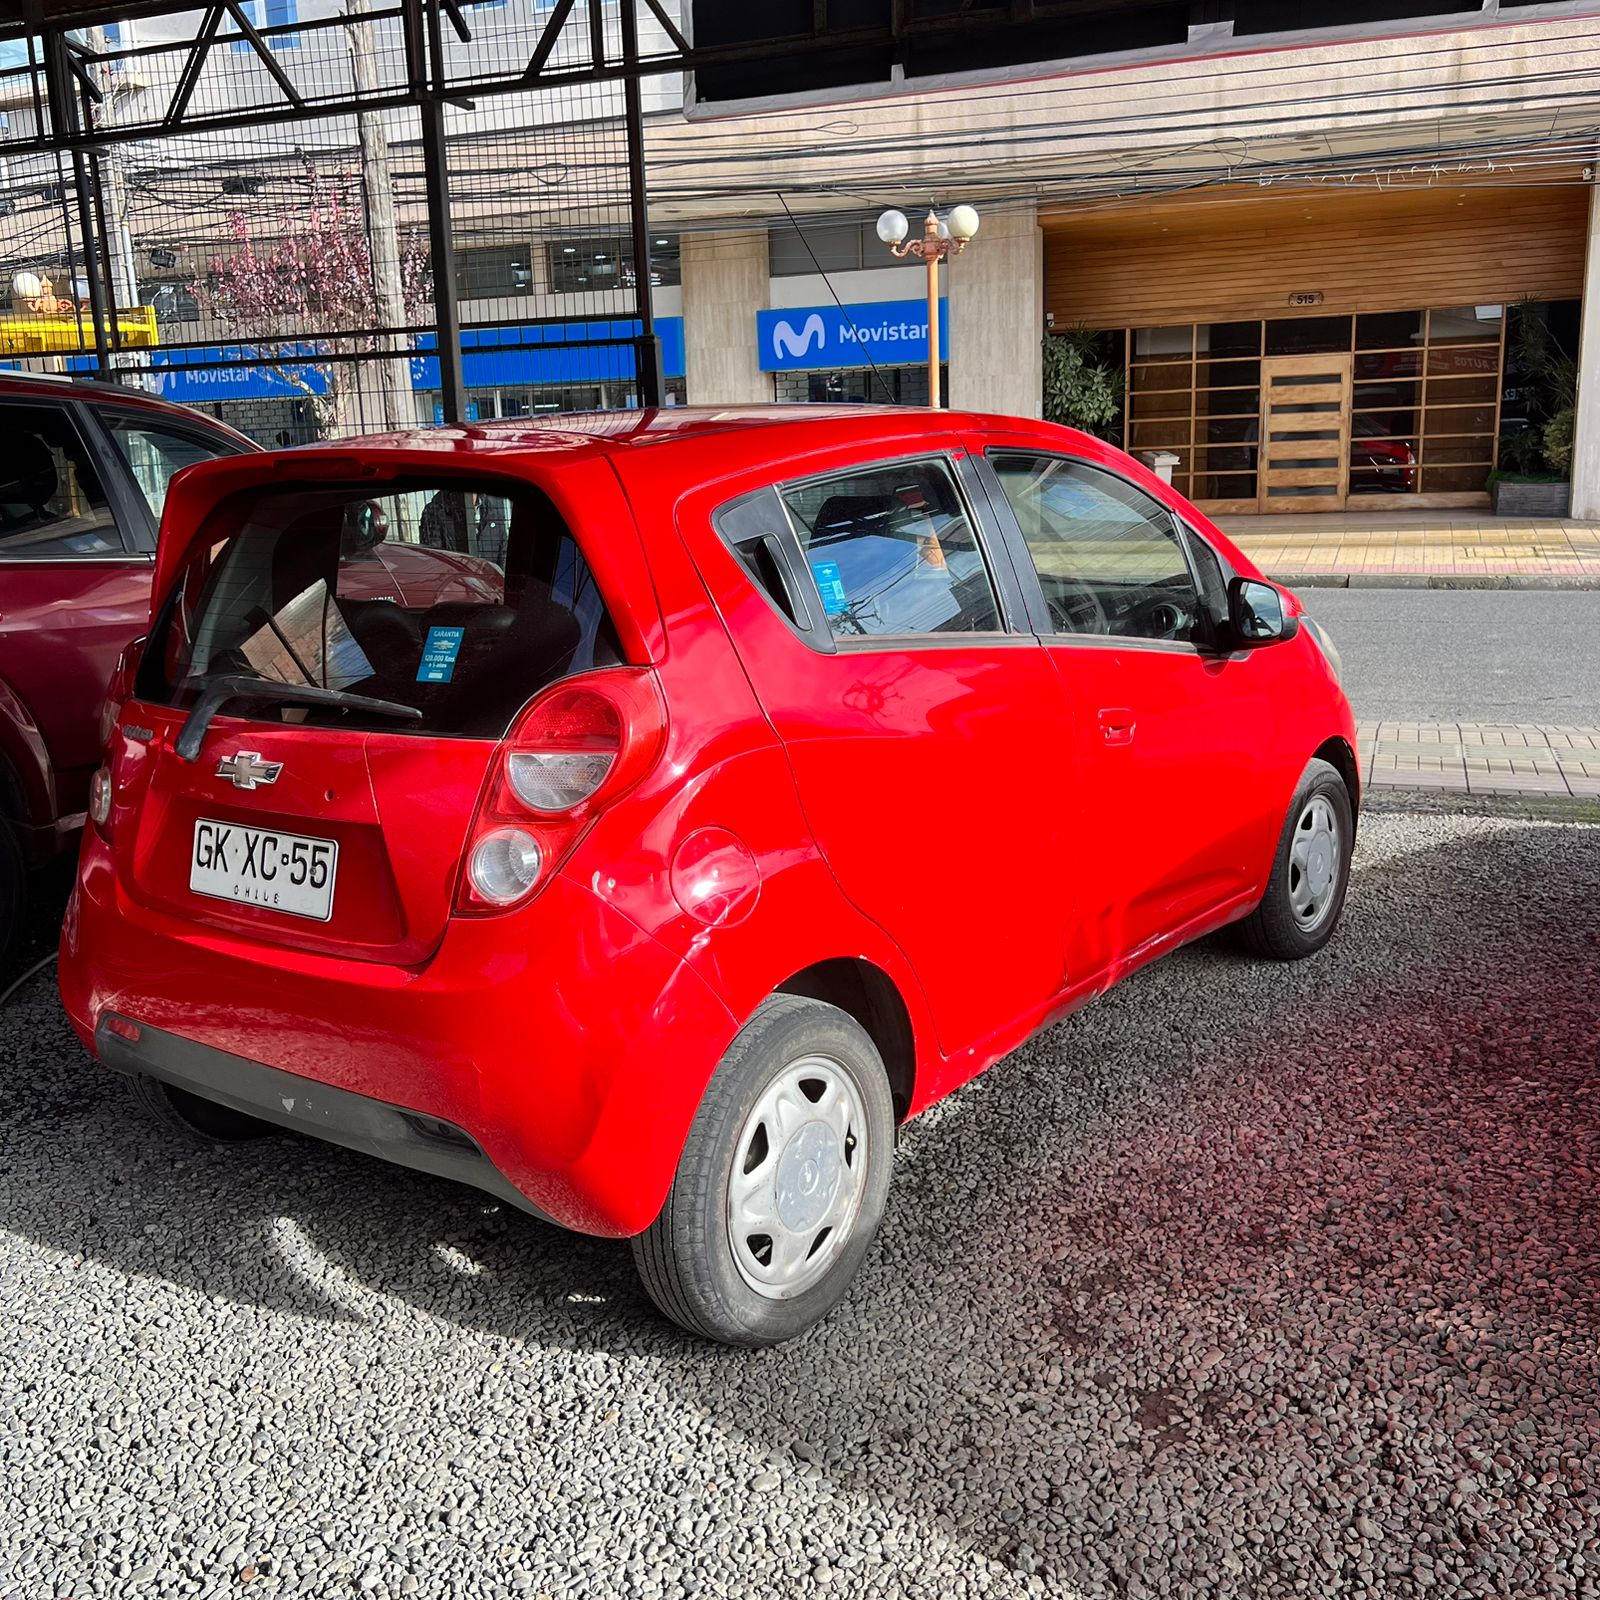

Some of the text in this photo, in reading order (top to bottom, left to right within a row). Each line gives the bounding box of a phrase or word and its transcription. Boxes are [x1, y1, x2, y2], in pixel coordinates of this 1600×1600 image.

[1296, 294, 1315, 305] 515
[839, 321, 929, 344] Movistar
[233, 884, 279, 904] CHILE
